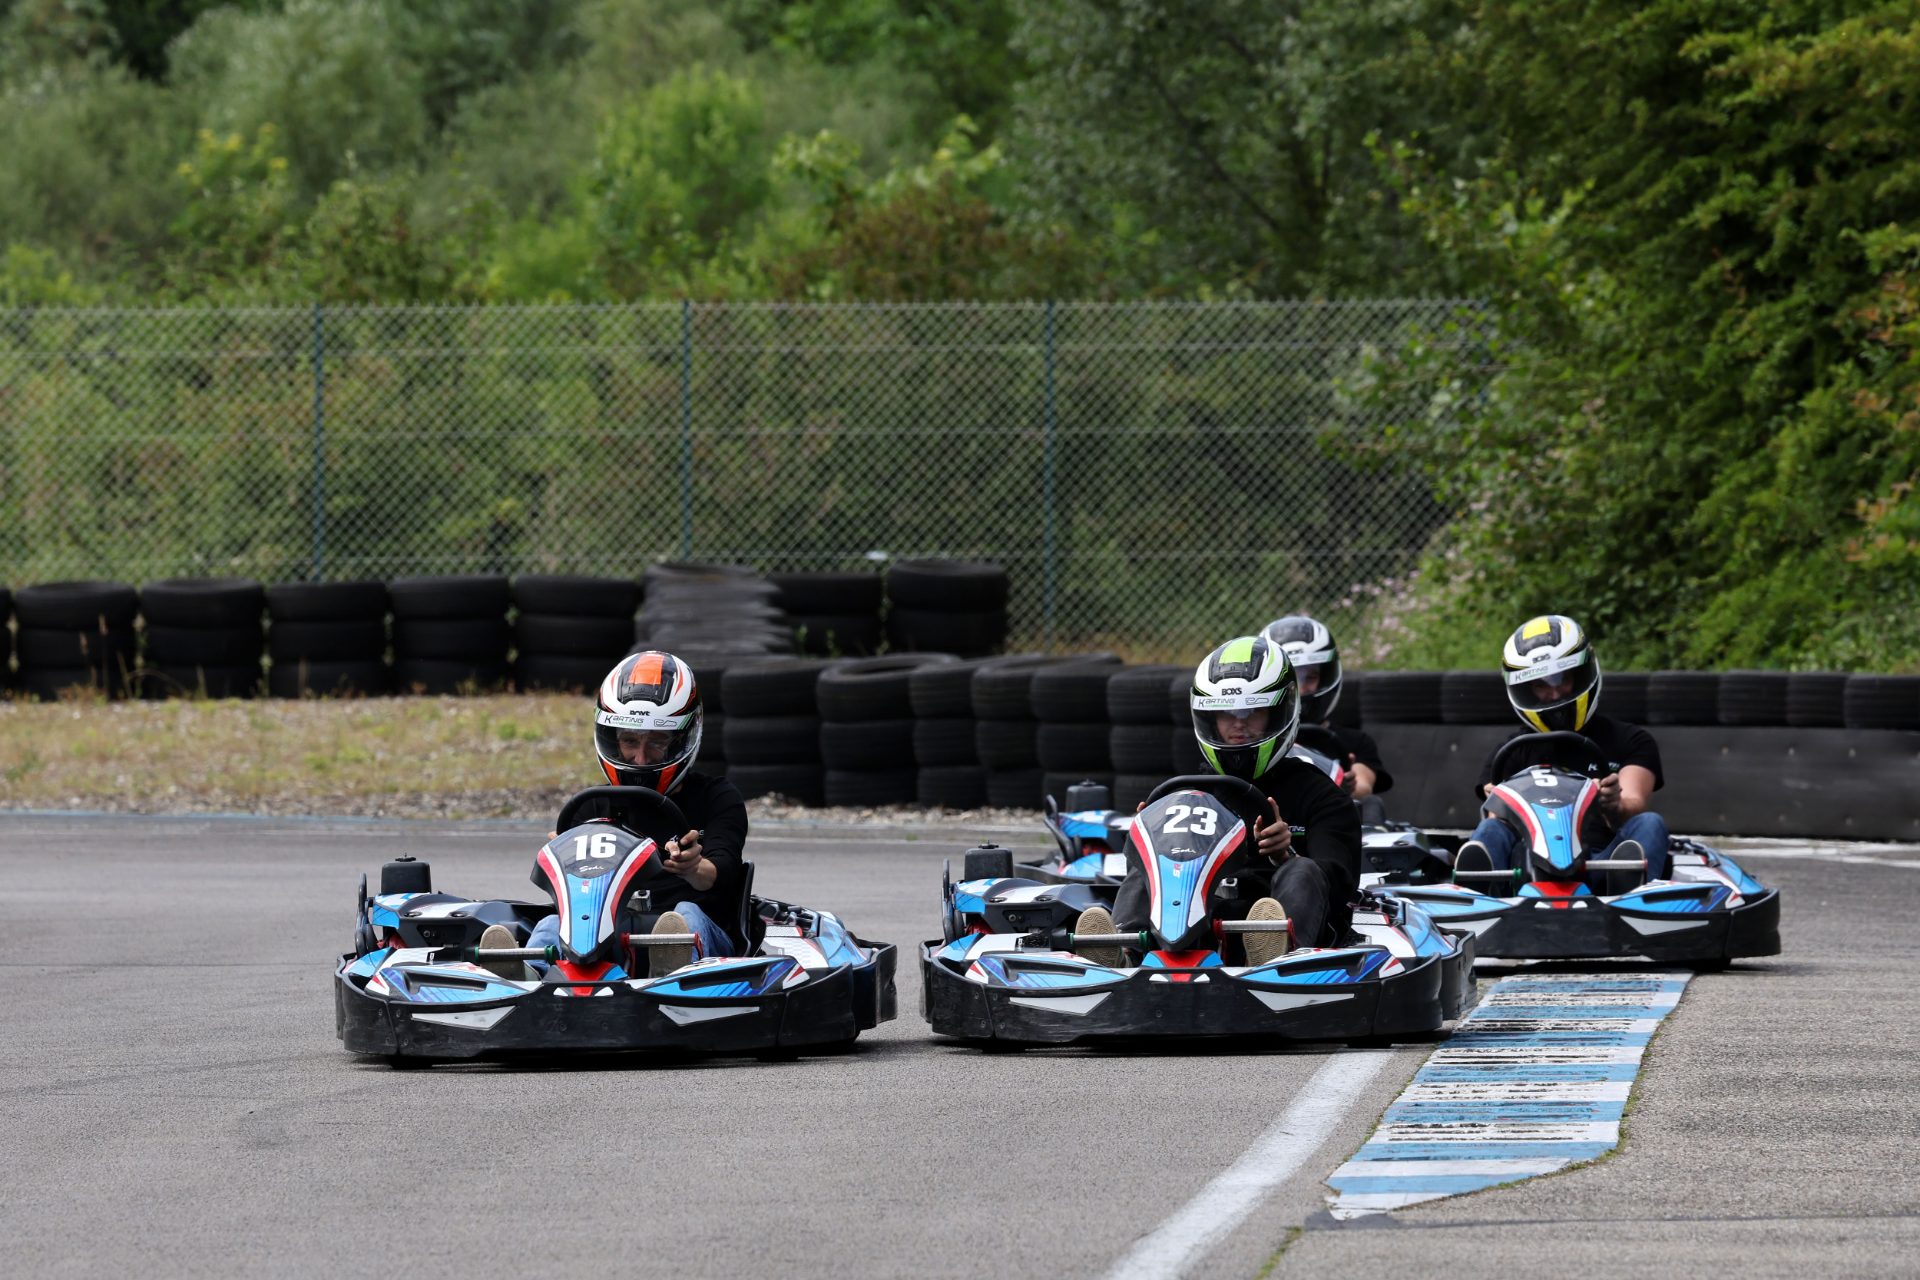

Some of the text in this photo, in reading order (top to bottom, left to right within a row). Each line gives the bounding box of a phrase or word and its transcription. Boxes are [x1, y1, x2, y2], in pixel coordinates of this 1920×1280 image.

[1221, 687, 1243, 696] BOXS
[1530, 768, 1559, 787] 5
[1163, 804, 1218, 836] 23
[574, 833, 617, 861] 16
